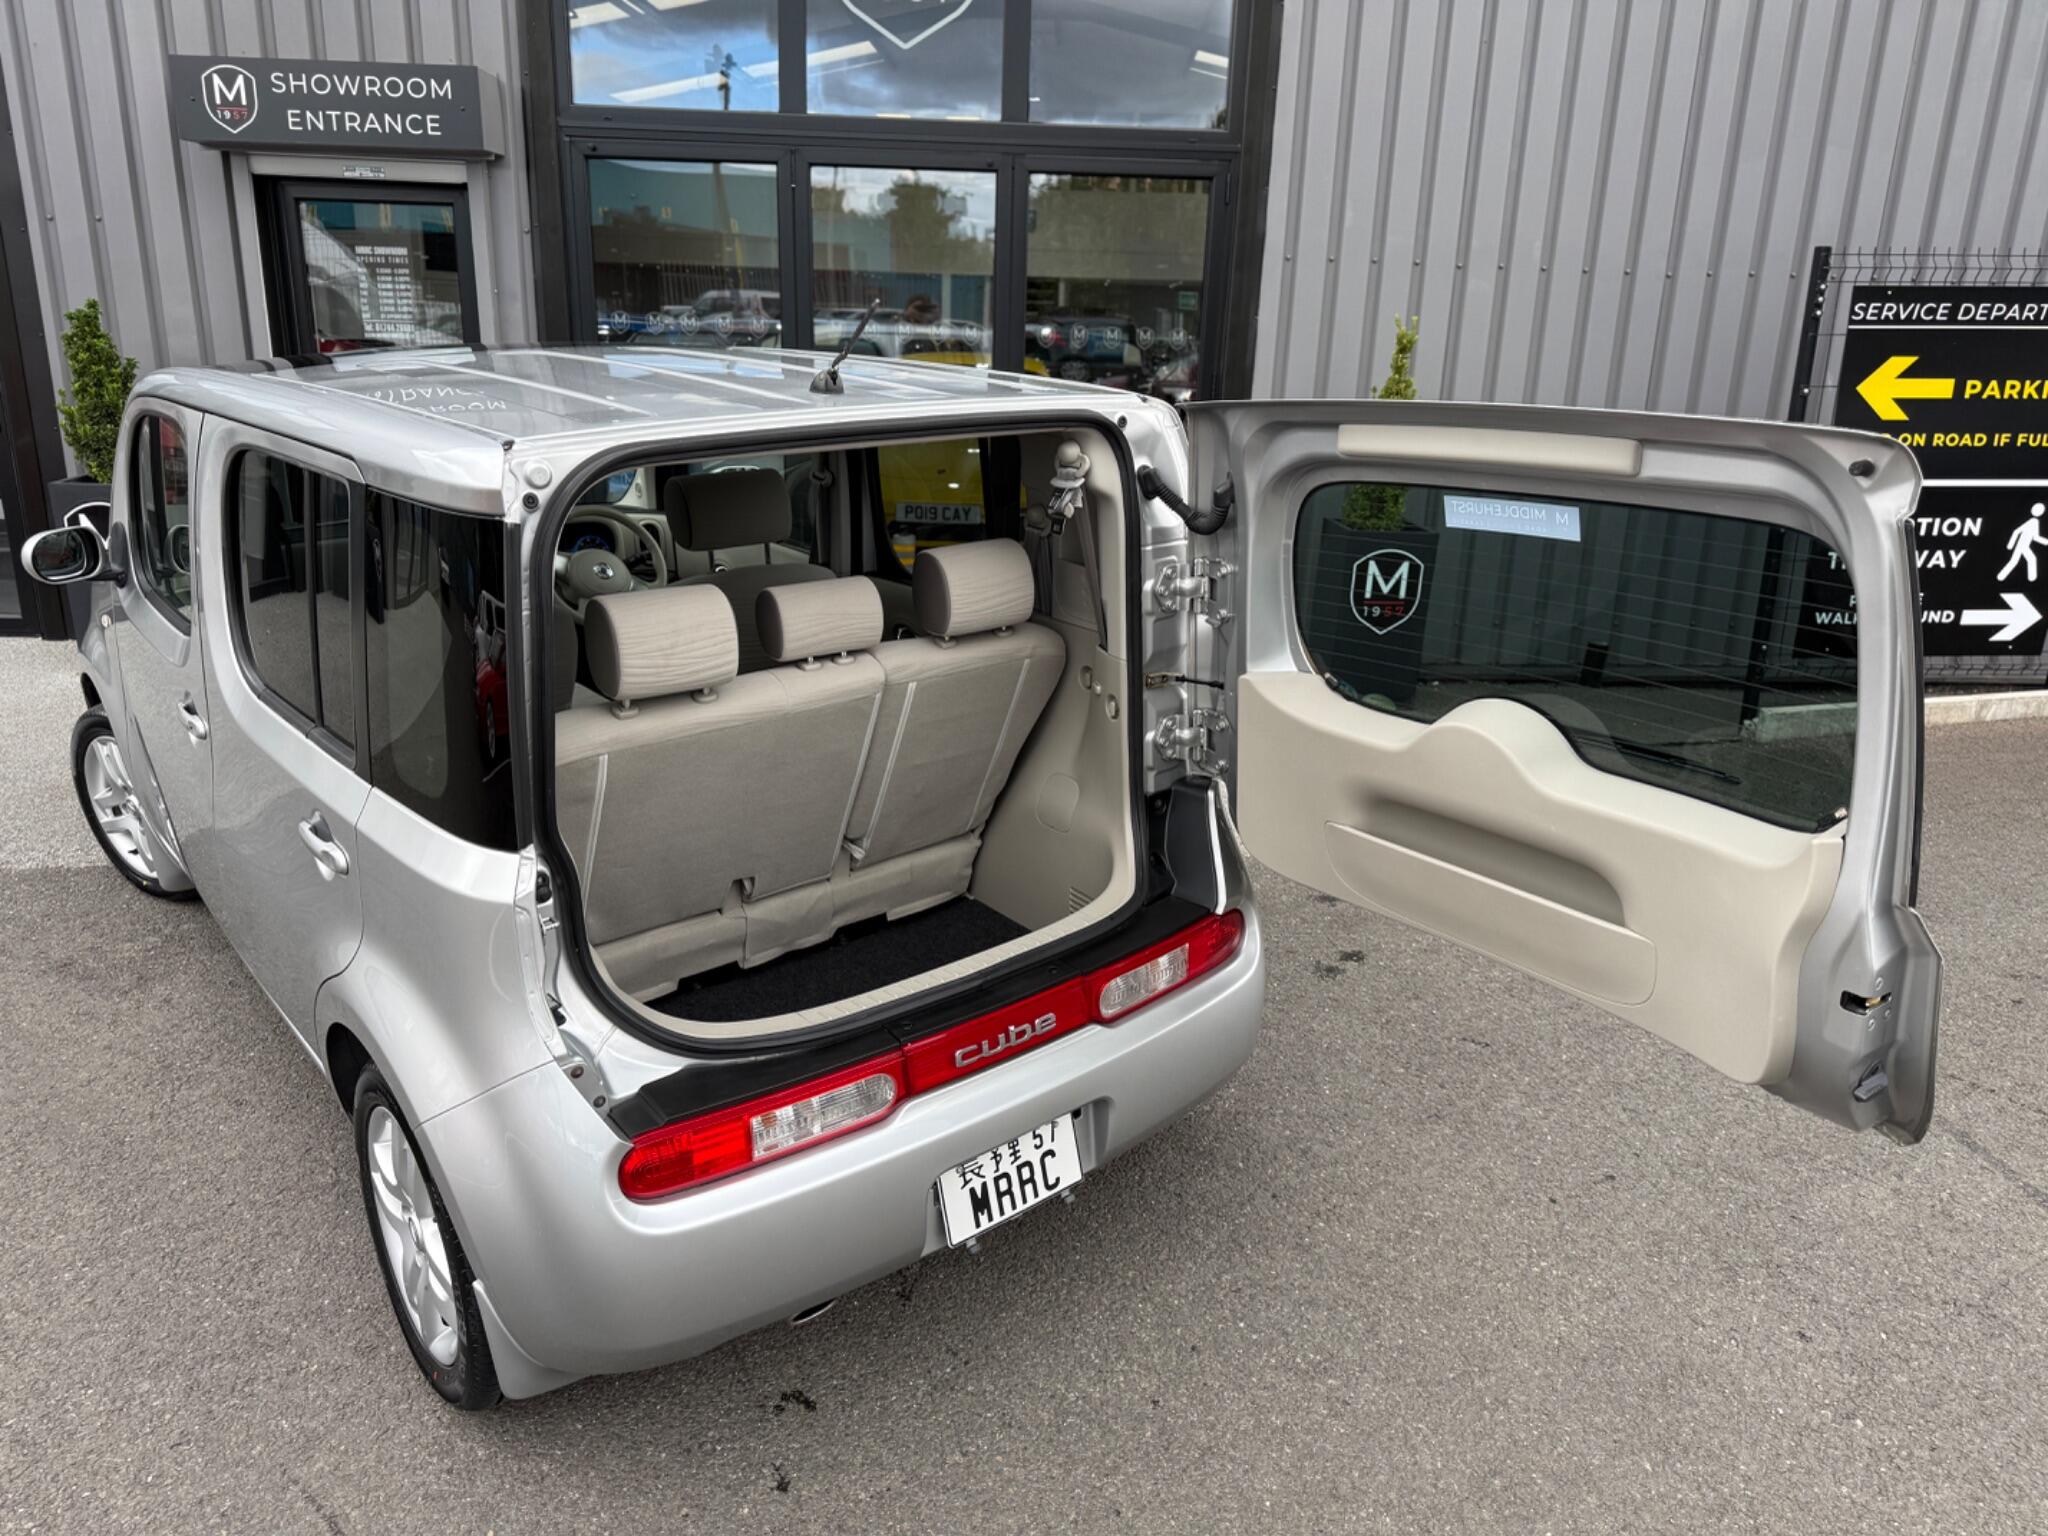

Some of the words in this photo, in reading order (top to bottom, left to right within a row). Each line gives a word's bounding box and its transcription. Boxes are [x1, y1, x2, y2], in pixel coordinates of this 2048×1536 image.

[212, 72, 247, 105] M
[270, 72, 453, 100] SHOWROOM
[286, 109, 442, 136] ENTRANCE
[1851, 302, 1952, 321] SERVICE
[1957, 303, 2048, 321] DEPART
[1964, 379, 2048, 399] PARKI
[1898, 432, 1927, 447] ON
[1932, 432, 1987, 447] ROAD
[1993, 433, 2012, 447] IF
[941, 506, 972, 522] CAY
[1364, 559, 1410, 599] M
[955, 1012, 1057, 1068] cube
